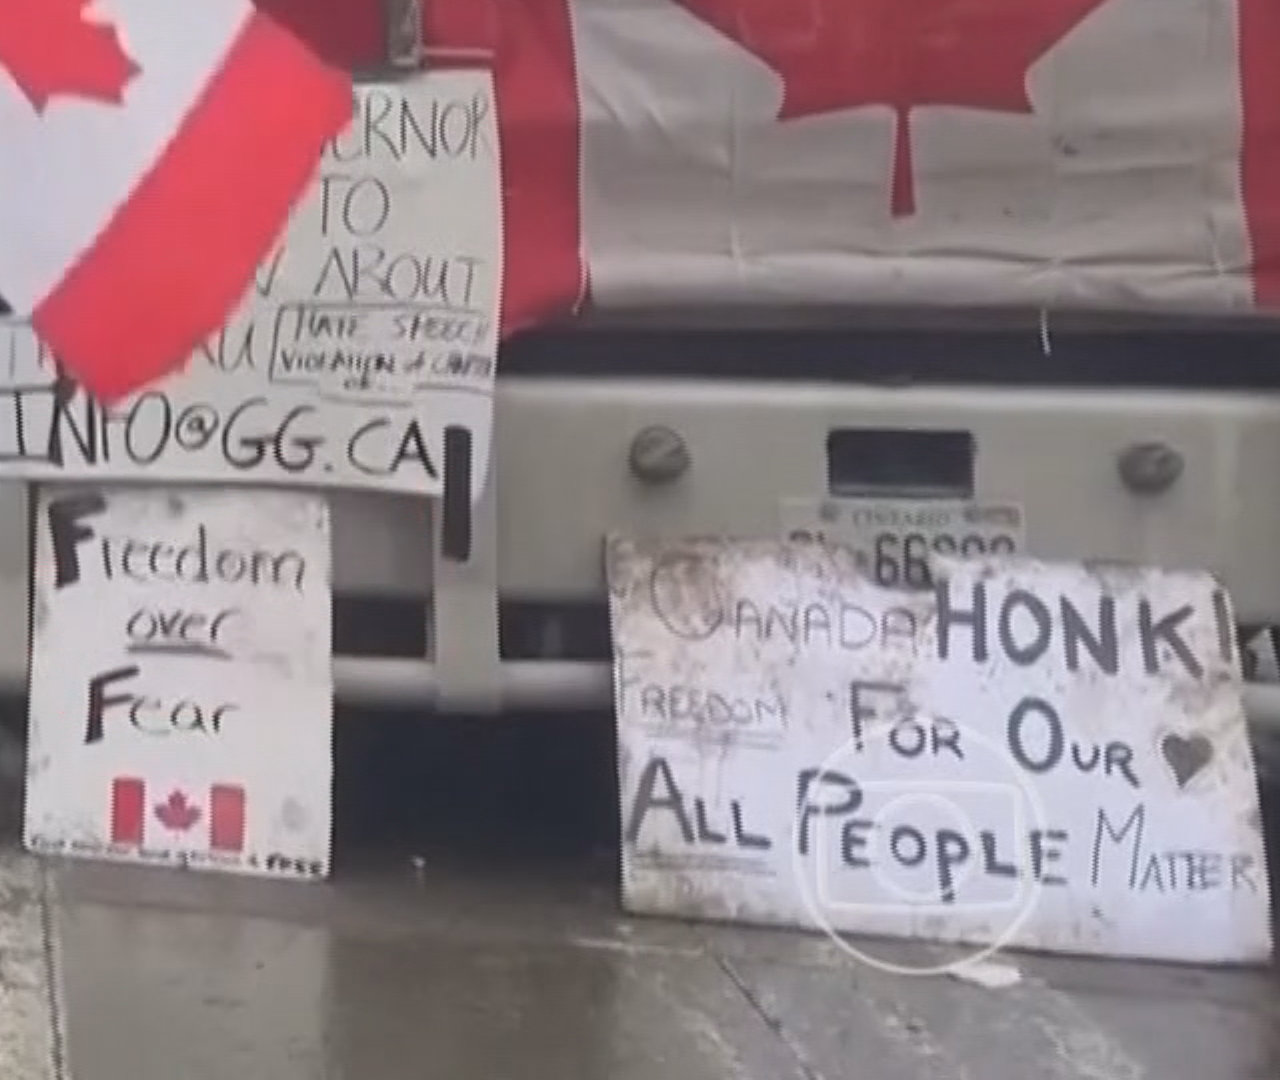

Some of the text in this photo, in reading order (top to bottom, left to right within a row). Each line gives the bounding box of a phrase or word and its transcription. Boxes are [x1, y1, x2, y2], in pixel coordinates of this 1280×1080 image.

[320, 174, 391, 238] TO
[313, 245, 485, 304] ABOUT
[48, 489, 306, 593] Freedom
[125, 609, 240, 644] over
[936, 580, 1235, 682] HONK!
[84, 665, 240, 746] Fear
